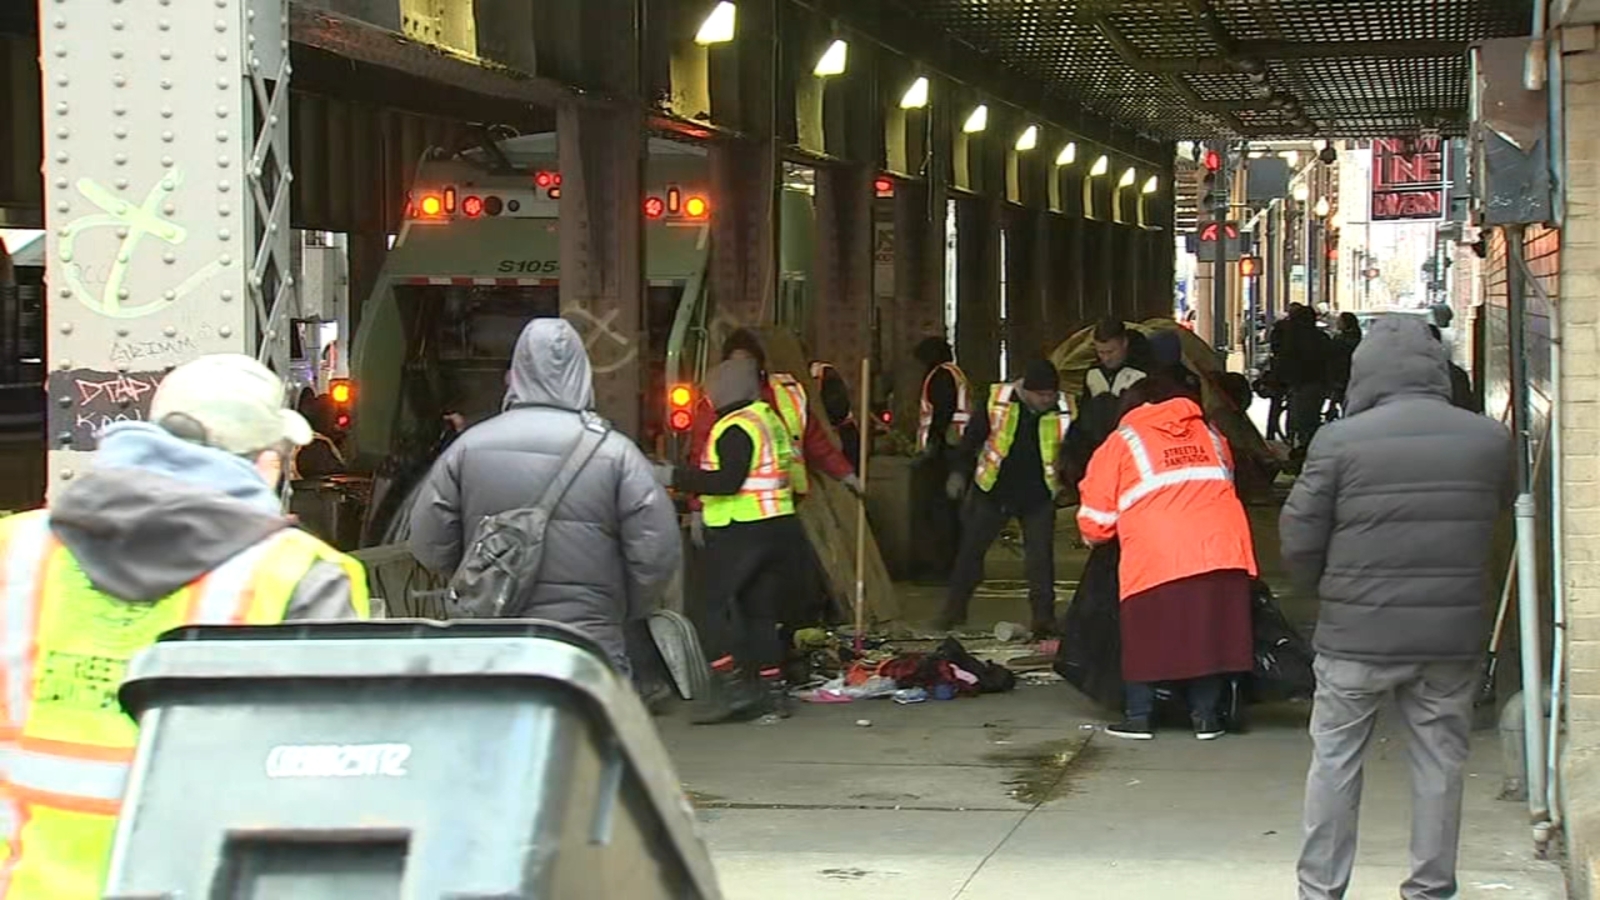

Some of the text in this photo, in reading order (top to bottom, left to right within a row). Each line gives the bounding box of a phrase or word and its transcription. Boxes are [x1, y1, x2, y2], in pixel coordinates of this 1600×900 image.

[1374, 138, 1440, 155] NW
[1374, 153, 1441, 190] LINE
[498, 260, 560, 273] S105
[1163, 445, 1198, 458] STREETS
